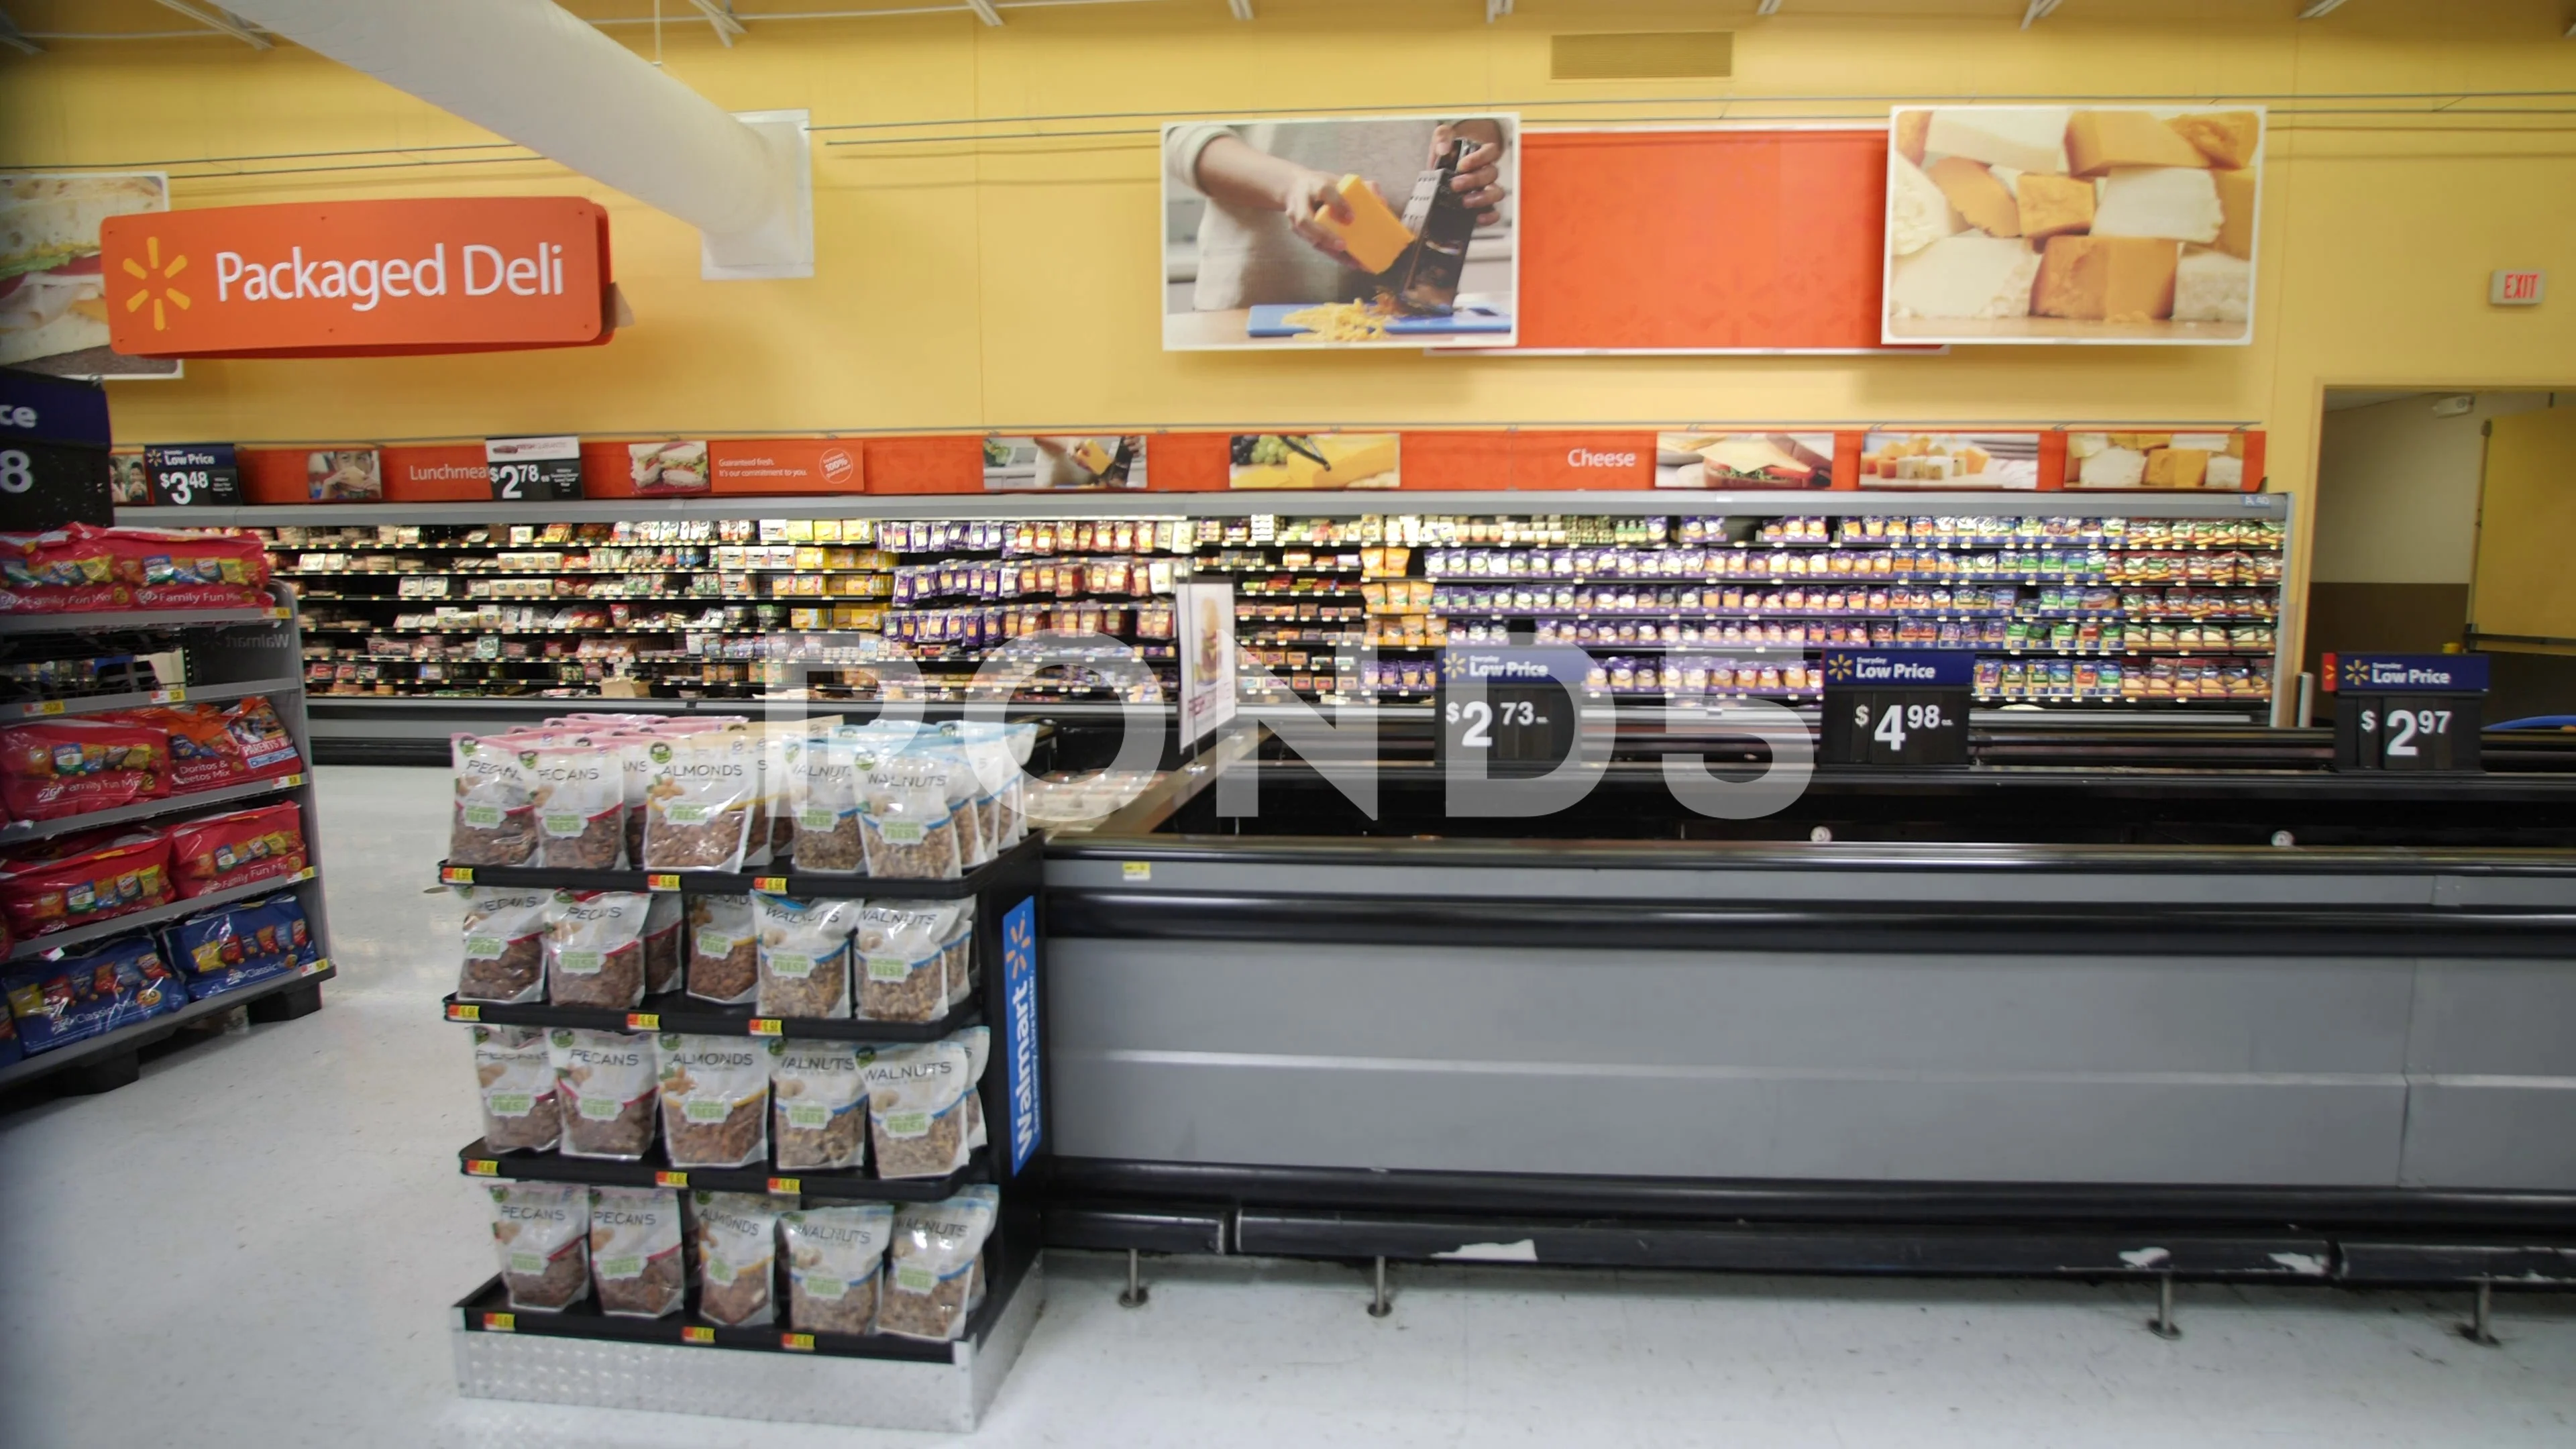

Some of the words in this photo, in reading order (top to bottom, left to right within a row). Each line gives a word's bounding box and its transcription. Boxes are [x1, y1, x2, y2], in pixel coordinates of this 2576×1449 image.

[215, 242, 447, 312] Packaged
[463, 241, 564, 297] Deli
[2504, 273, 2539, 299] EXIT
[164, 453, 187, 466] Low
[188, 453, 215, 465] Price
[1567, 447, 1636, 467] Cheese
[409, 464, 488, 481] Lunchmea
[159, 592, 201, 604] Family
[203, 592, 224, 602] Fun
[1470, 661, 1504, 677] Low
[1507, 661, 1549, 677] Price
[1856, 663, 1891, 679] Low
[1893, 663, 1936, 679] Price
[2371, 669, 2406, 684] Low
[2408, 669, 2452, 684] Price
[179, 761, 218, 775] Doritos
[219, 760, 229, 768] &
[213, 769, 231, 778] Mix
[661, 764, 743, 777] ALMONDS
[867, 772, 947, 788] WALNUTS
[570, 1049, 639, 1067] PECANS
[672, 1052, 755, 1067] ALMONDS
[864, 1061, 954, 1081] WALNUTS
[1012, 979, 1034, 1161] Walmart
[500, 1205, 566, 1222] PECANS
[593, 1211, 657, 1226] PECANS
[699, 1209, 761, 1237] ALMONDS
[894, 1215, 969, 1238] WALNUTS
[798, 1223, 871, 1244] WALNUTS
